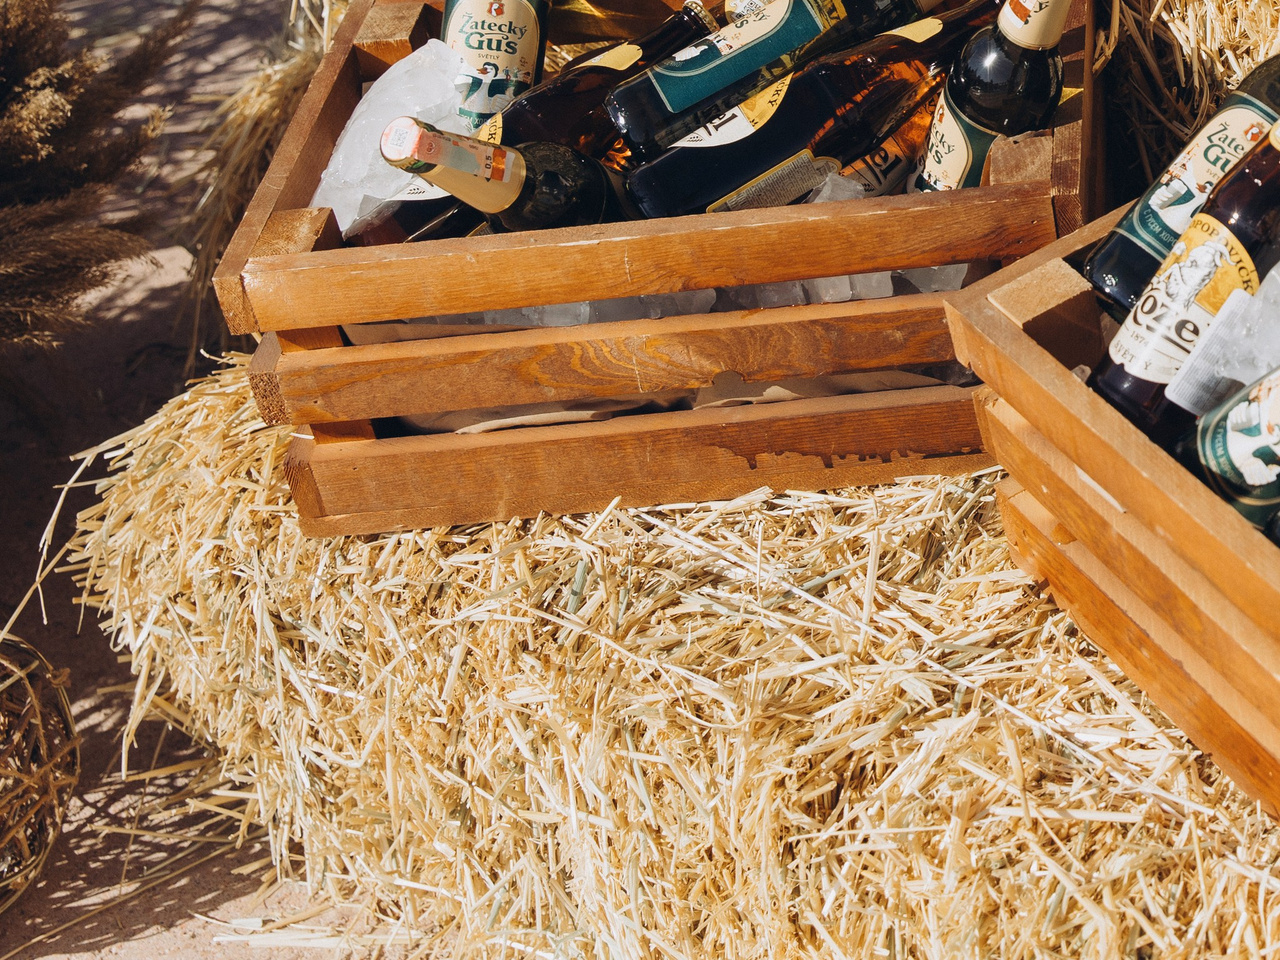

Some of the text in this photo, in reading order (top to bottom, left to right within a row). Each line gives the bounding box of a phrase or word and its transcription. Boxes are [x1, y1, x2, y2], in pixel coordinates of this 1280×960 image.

[458, 11, 528, 40] Žatecký
[464, 31, 519, 55] Gus
[1206, 121, 1248, 158] Žate
[484, 155, 493, 170] 0,5
[1144, 214, 1161, 234] ГУСЕМ
[1159, 229, 1178, 247] ХОРО
[1113, 341, 1152, 371] SVĚTÝ
